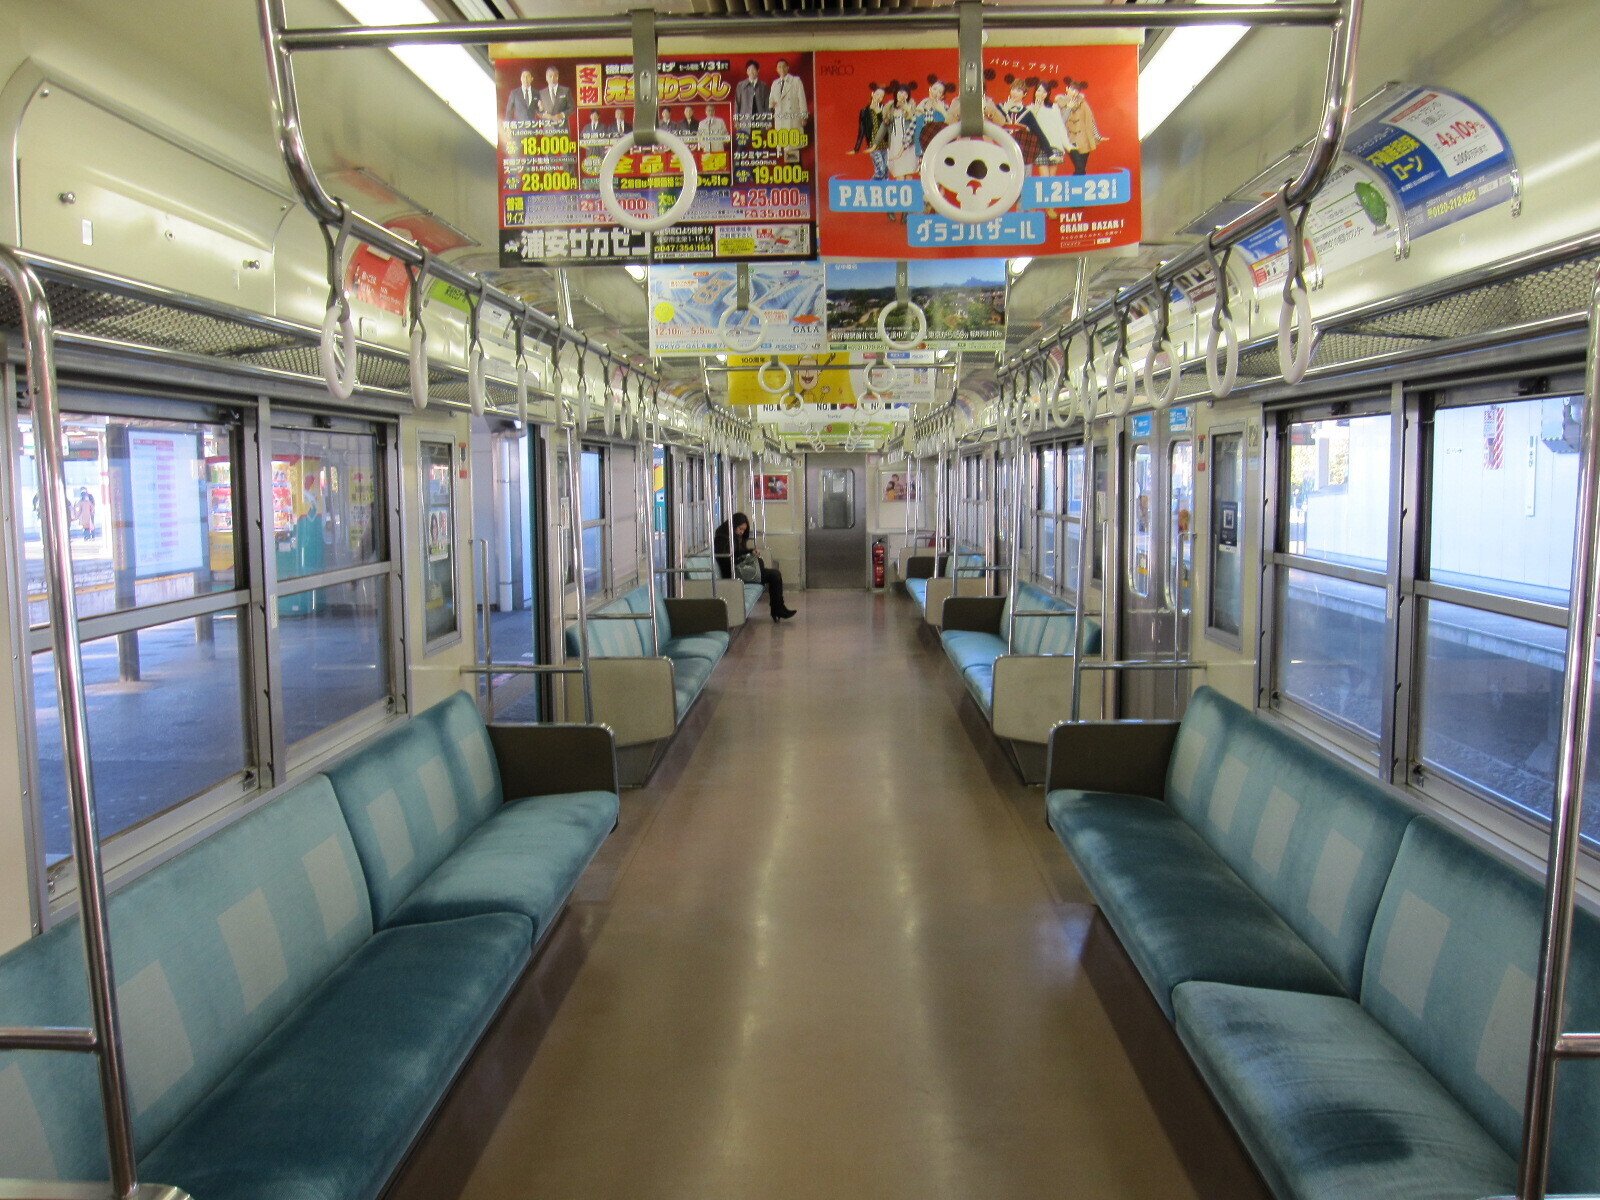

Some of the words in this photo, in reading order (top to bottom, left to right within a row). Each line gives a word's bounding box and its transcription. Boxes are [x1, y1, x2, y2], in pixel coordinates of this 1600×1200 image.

[579, 66, 599, 104] 冬物
[521, 136, 577, 155] 18,000円
[751, 128, 808, 148] 5,000円
[752, 165, 809, 184] 19,000円
[1391, 155, 1424, 181] ローン
[521, 171, 578, 191] 28,000円
[748, 187, 808, 207] 25,000円
[838, 185, 913, 207] PARCO
[1059, 213, 1083, 222] PLAY
[916, 218, 1036, 242] グランバザール
[1059, 223, 1089, 234] GRAND
[792, 325, 820, 334] GALA
